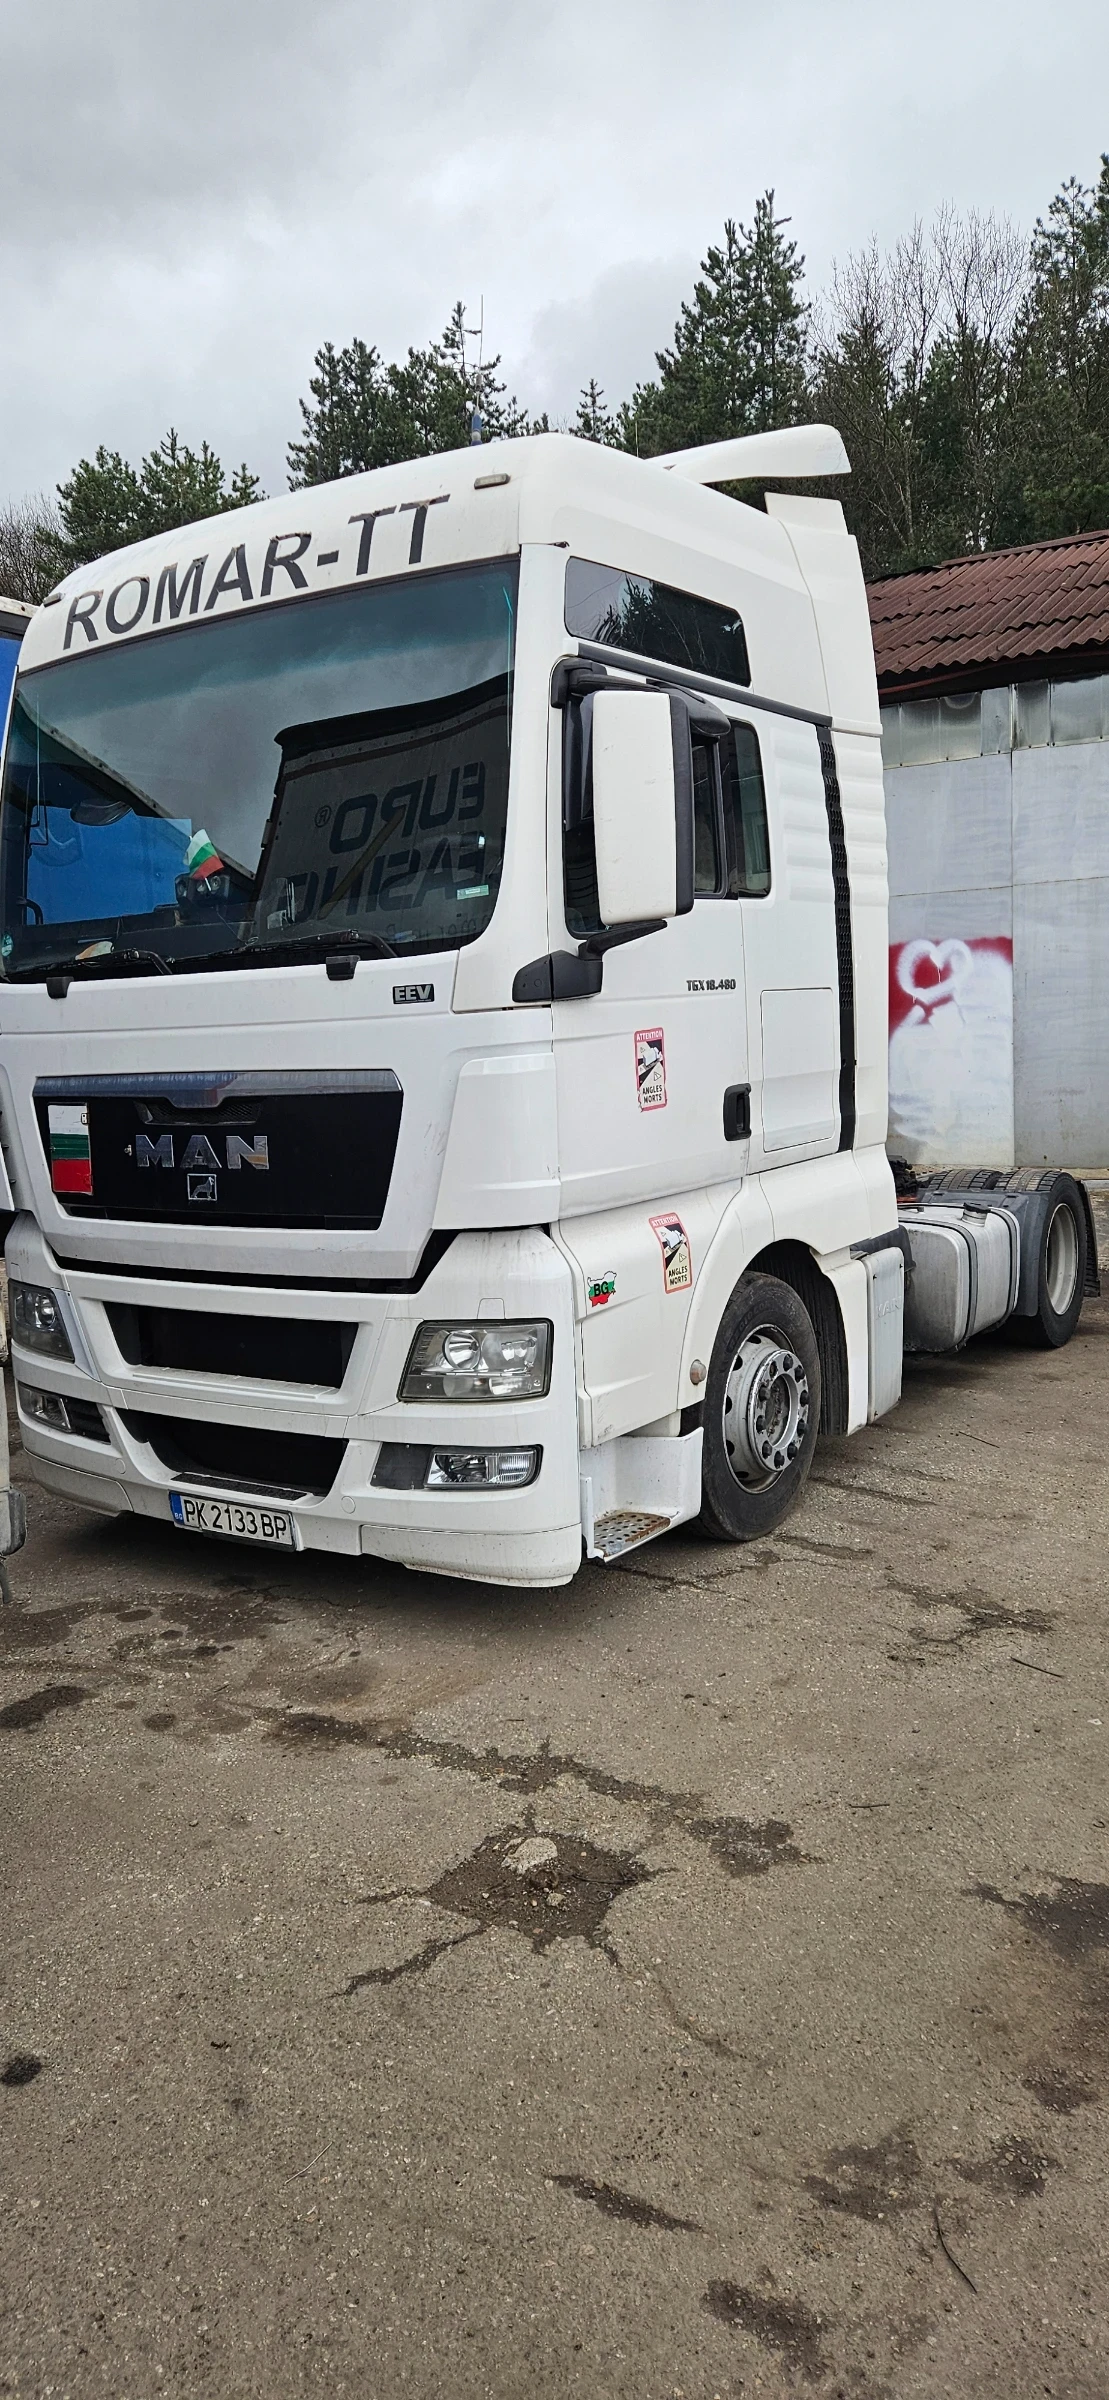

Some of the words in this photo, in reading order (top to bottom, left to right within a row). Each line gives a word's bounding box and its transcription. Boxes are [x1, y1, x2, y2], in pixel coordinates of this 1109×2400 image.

[63, 494, 450, 650] ROMAR-TT
[686, 979, 705, 991] TGX
[706, 979, 737, 990] 18.480
[394, 985, 432, 1001] EEV
[637, 1030, 662, 1041] ATTENTION
[642, 1085, 663, 1094] ANGLES
[643, 1094, 662, 1103] MORTS
[136, 1135, 270, 1170] MAN
[668, 1266, 688, 1277] ANGLES
[669, 1275, 688, 1286] MORTS
[593, 1281, 609, 1297] BG
[174, 1512, 183, 1521] BG
[211, 1505, 258, 1535] 2133
[261, 1513, 287, 1539] BP
